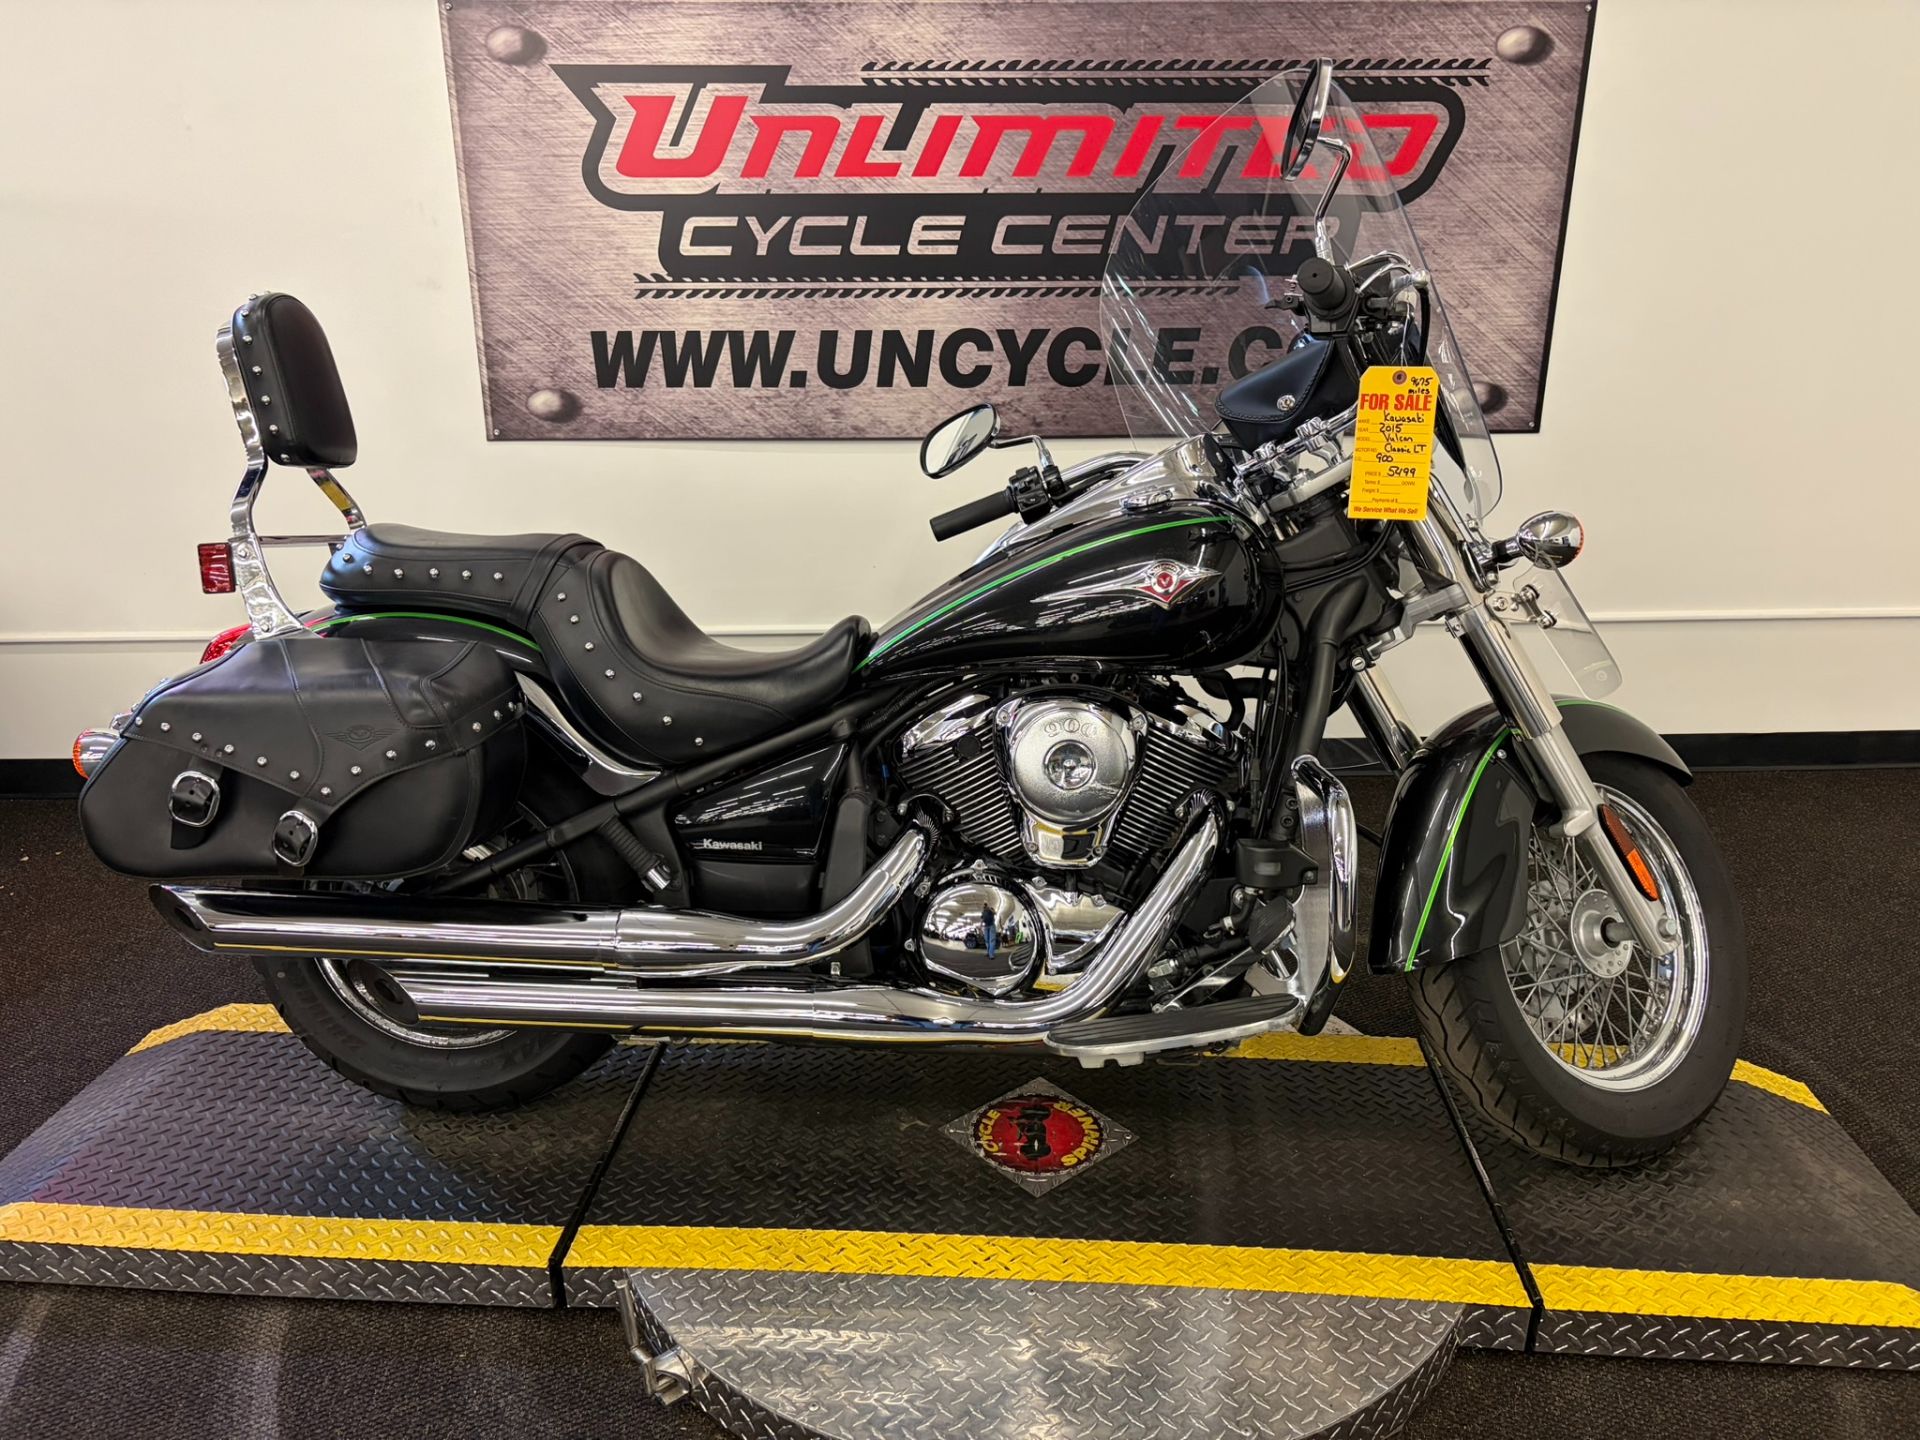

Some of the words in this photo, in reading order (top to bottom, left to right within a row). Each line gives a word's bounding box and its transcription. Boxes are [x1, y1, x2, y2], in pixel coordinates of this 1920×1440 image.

[678, 214, 967, 256] CYCLE
[991, 214, 1340, 256] CENTER
[590, 326, 1301, 389] WWW.UNCYCLE.C
[1360, 393, 1389, 411] FOR
[1394, 393, 1432, 411] SALE
[1384, 410, 1425, 423] Kawasaki
[1379, 422, 1403, 433] 2015
[1384, 432, 1413, 442] Vulcan
[1384, 442, 1411, 453] Classic
[1413, 444, 1427, 453] LT
[1376, 452, 1394, 463] 900
[1387, 466, 1416, 477] 5499
[703, 838, 762, 851] Kawasaki
[978, 1109, 1001, 1153] CYCLE
[1053, 1100, 1101, 1167] SPINNER
